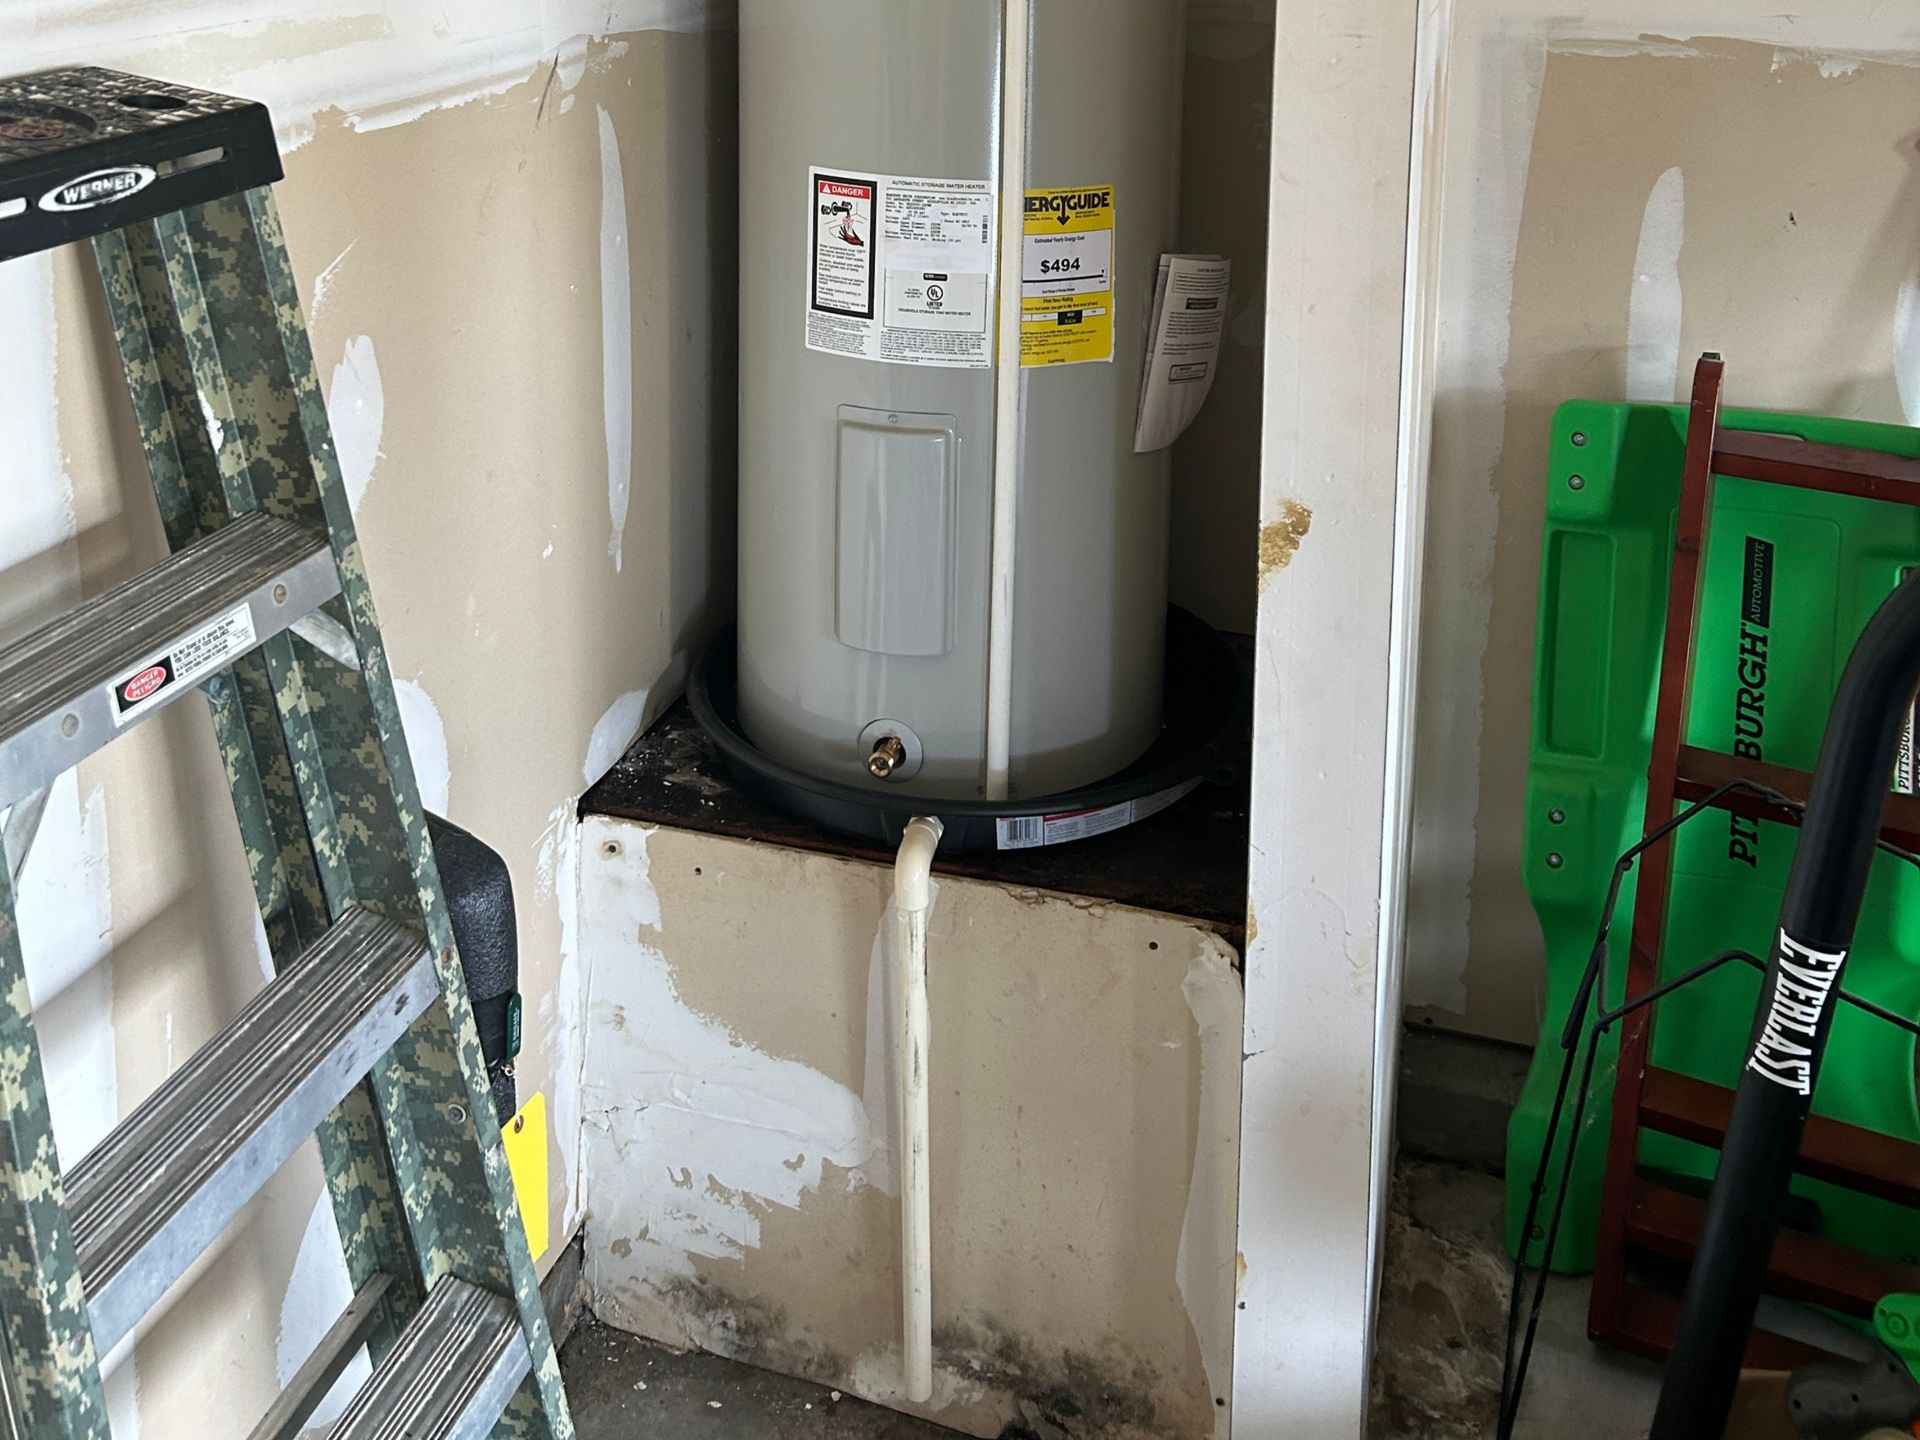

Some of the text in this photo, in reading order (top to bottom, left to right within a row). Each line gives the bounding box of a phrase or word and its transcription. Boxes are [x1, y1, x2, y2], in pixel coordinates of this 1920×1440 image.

[62, 173, 136, 204] WERNER
[831, 185, 864, 197] DANGER
[1040, 257, 1080, 274] $494
[930, 288, 940, 298] UL
[1750, 541, 1766, 624] AUTOMOTIVE
[131, 668, 159, 690] DANGER
[1748, 927, 1847, 1095] EVERLAST
